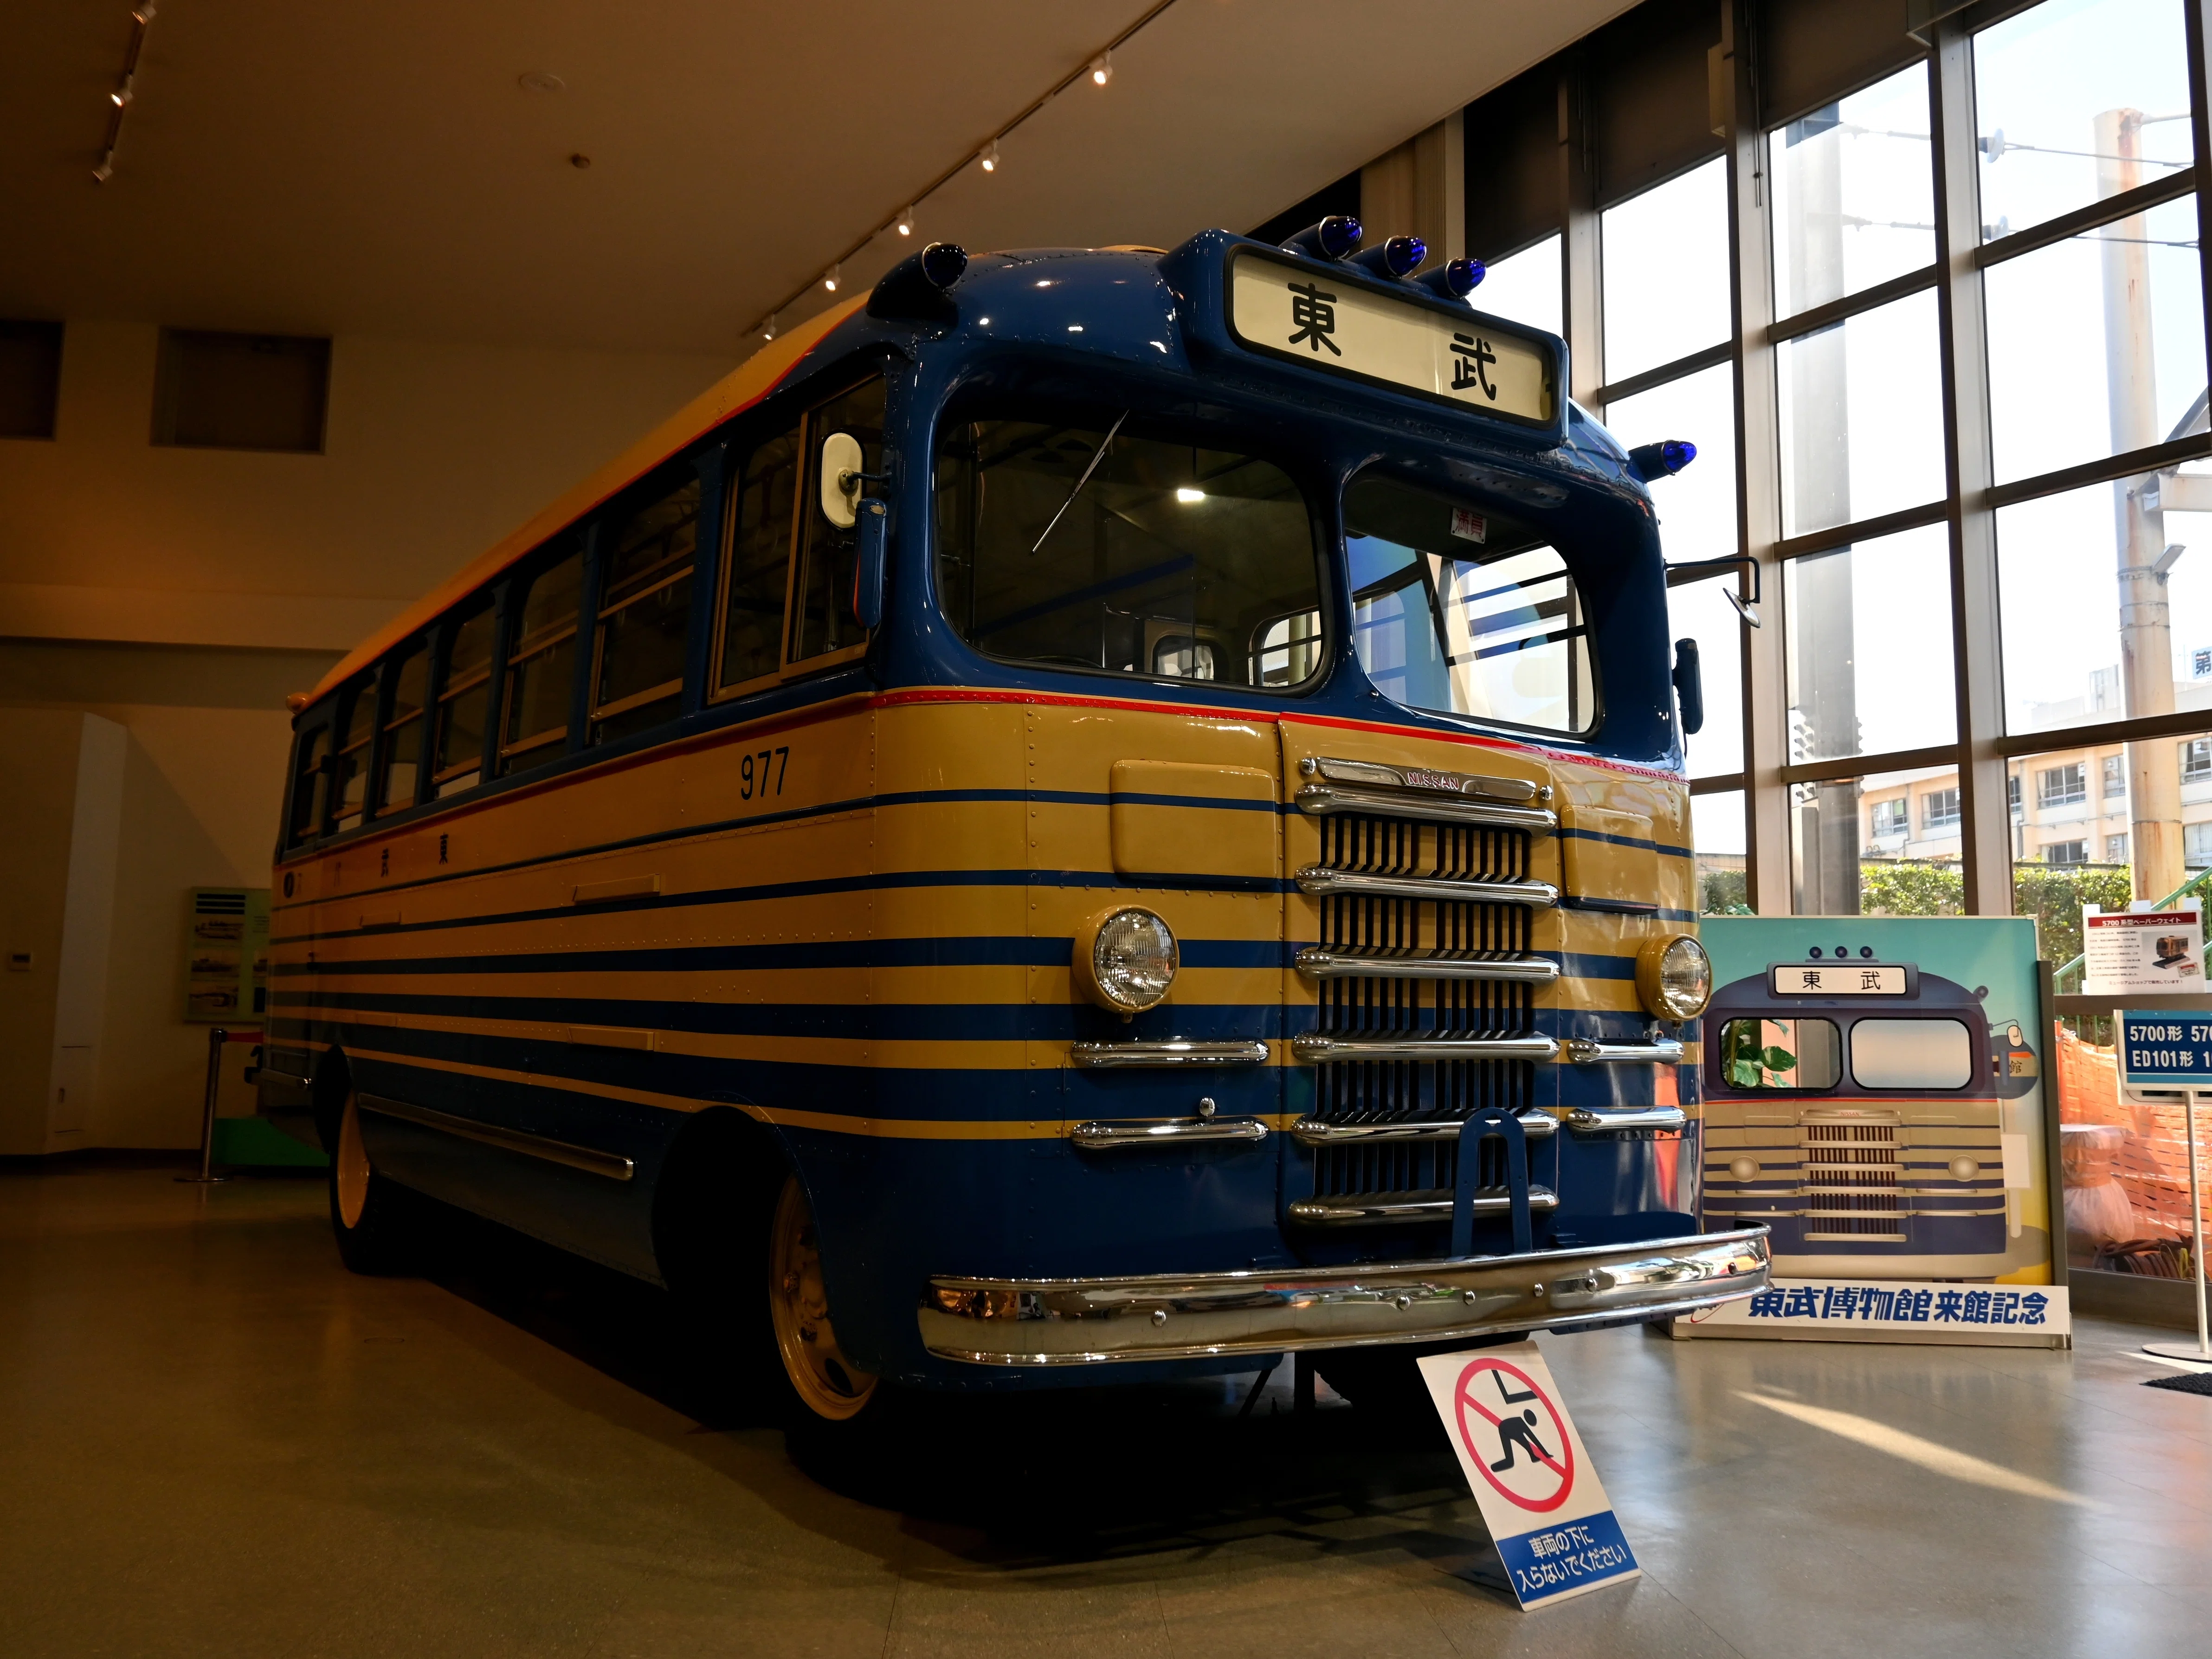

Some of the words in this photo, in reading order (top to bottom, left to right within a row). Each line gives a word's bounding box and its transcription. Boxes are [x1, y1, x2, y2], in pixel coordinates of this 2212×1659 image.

[1455, 509, 1483, 538] 満員
[741, 746, 789, 800] 977
[1407, 772, 1459, 790] NISSAN
[2132, 1050, 2194, 1067] ED101形
[1748, 1285, 2049, 1324] 東武博物館来館記念
[1528, 1525, 1595, 1560] 車両の下に
[1516, 1544, 1627, 1593] 入らないでください
